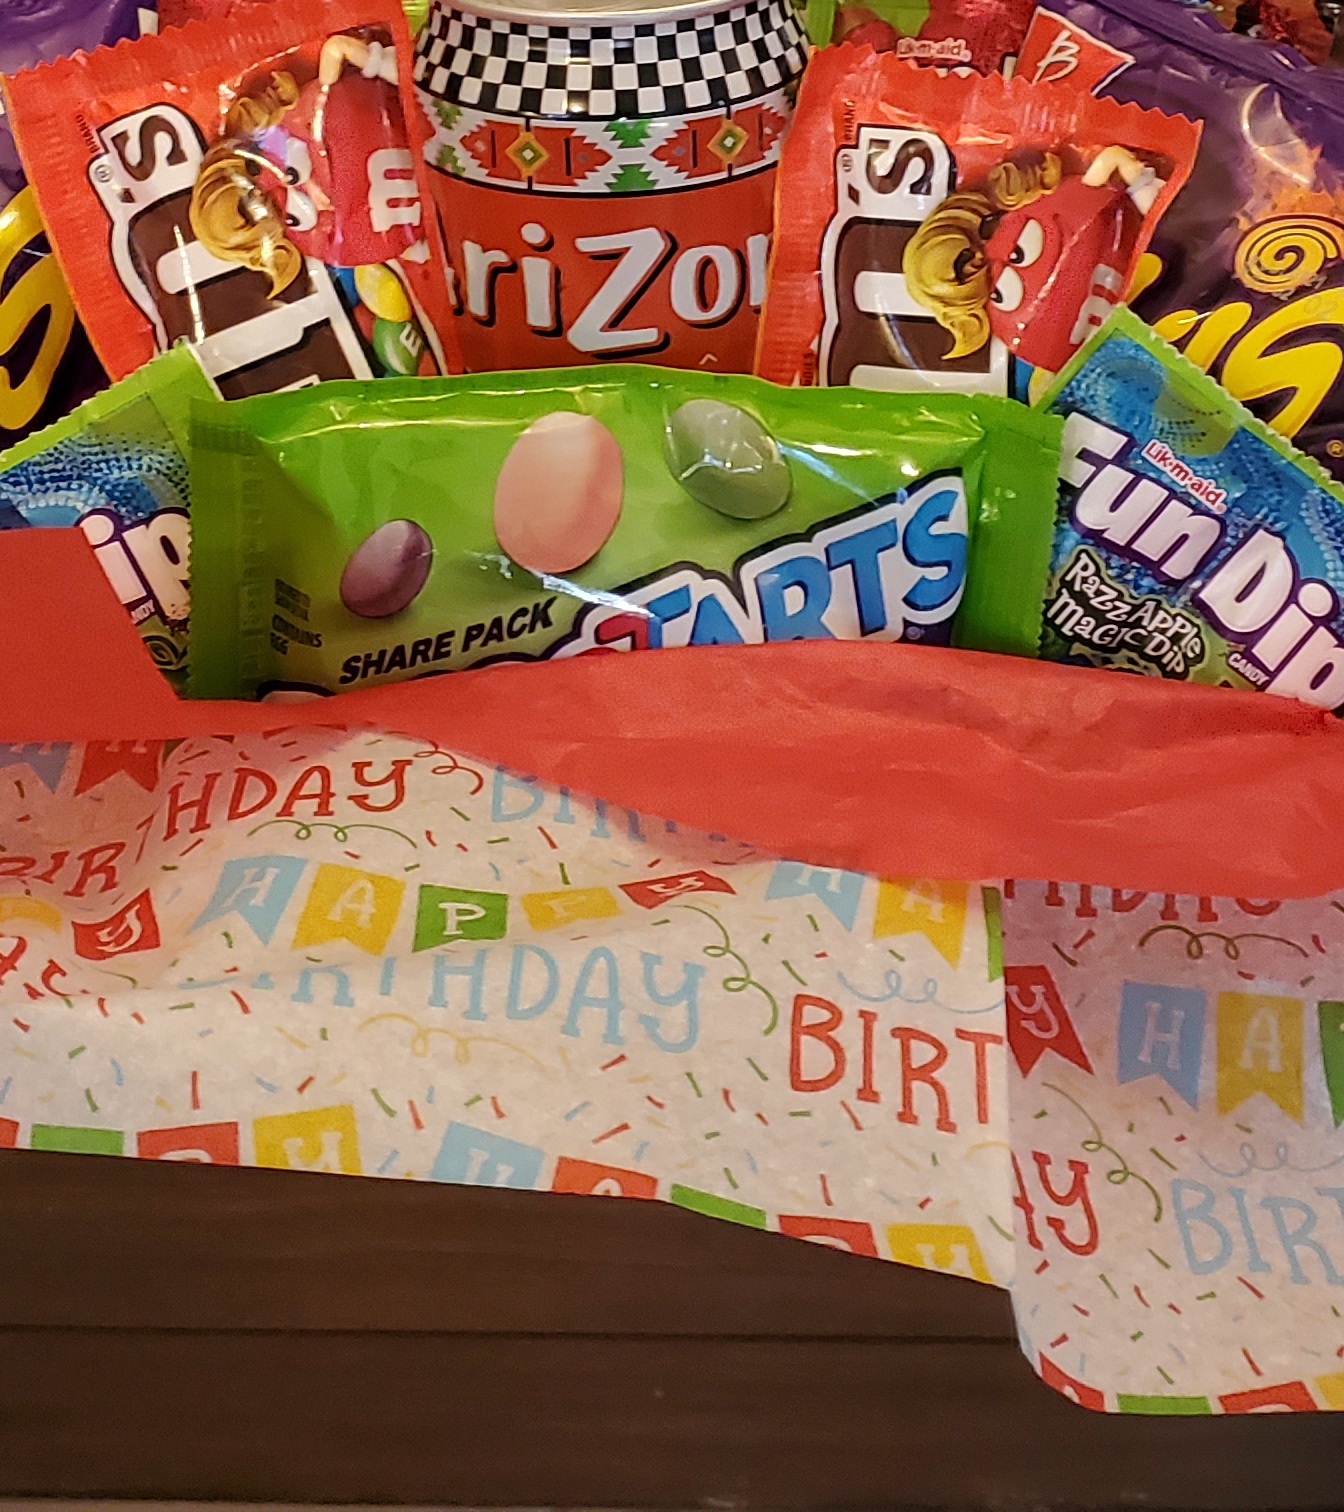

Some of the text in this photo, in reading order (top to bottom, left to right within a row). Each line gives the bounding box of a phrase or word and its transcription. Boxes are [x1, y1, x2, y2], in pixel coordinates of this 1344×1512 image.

[444, 222, 768, 352] riZo
[1057, 411, 1223, 580] Fun
[79, 513, 192, 621] ip
[646, 488, 968, 646] TARTS
[339, 595, 558, 684] SHARE PACK
[1228, 652, 1270, 686] CANDY
[790, 993, 1004, 1134] BIRT
